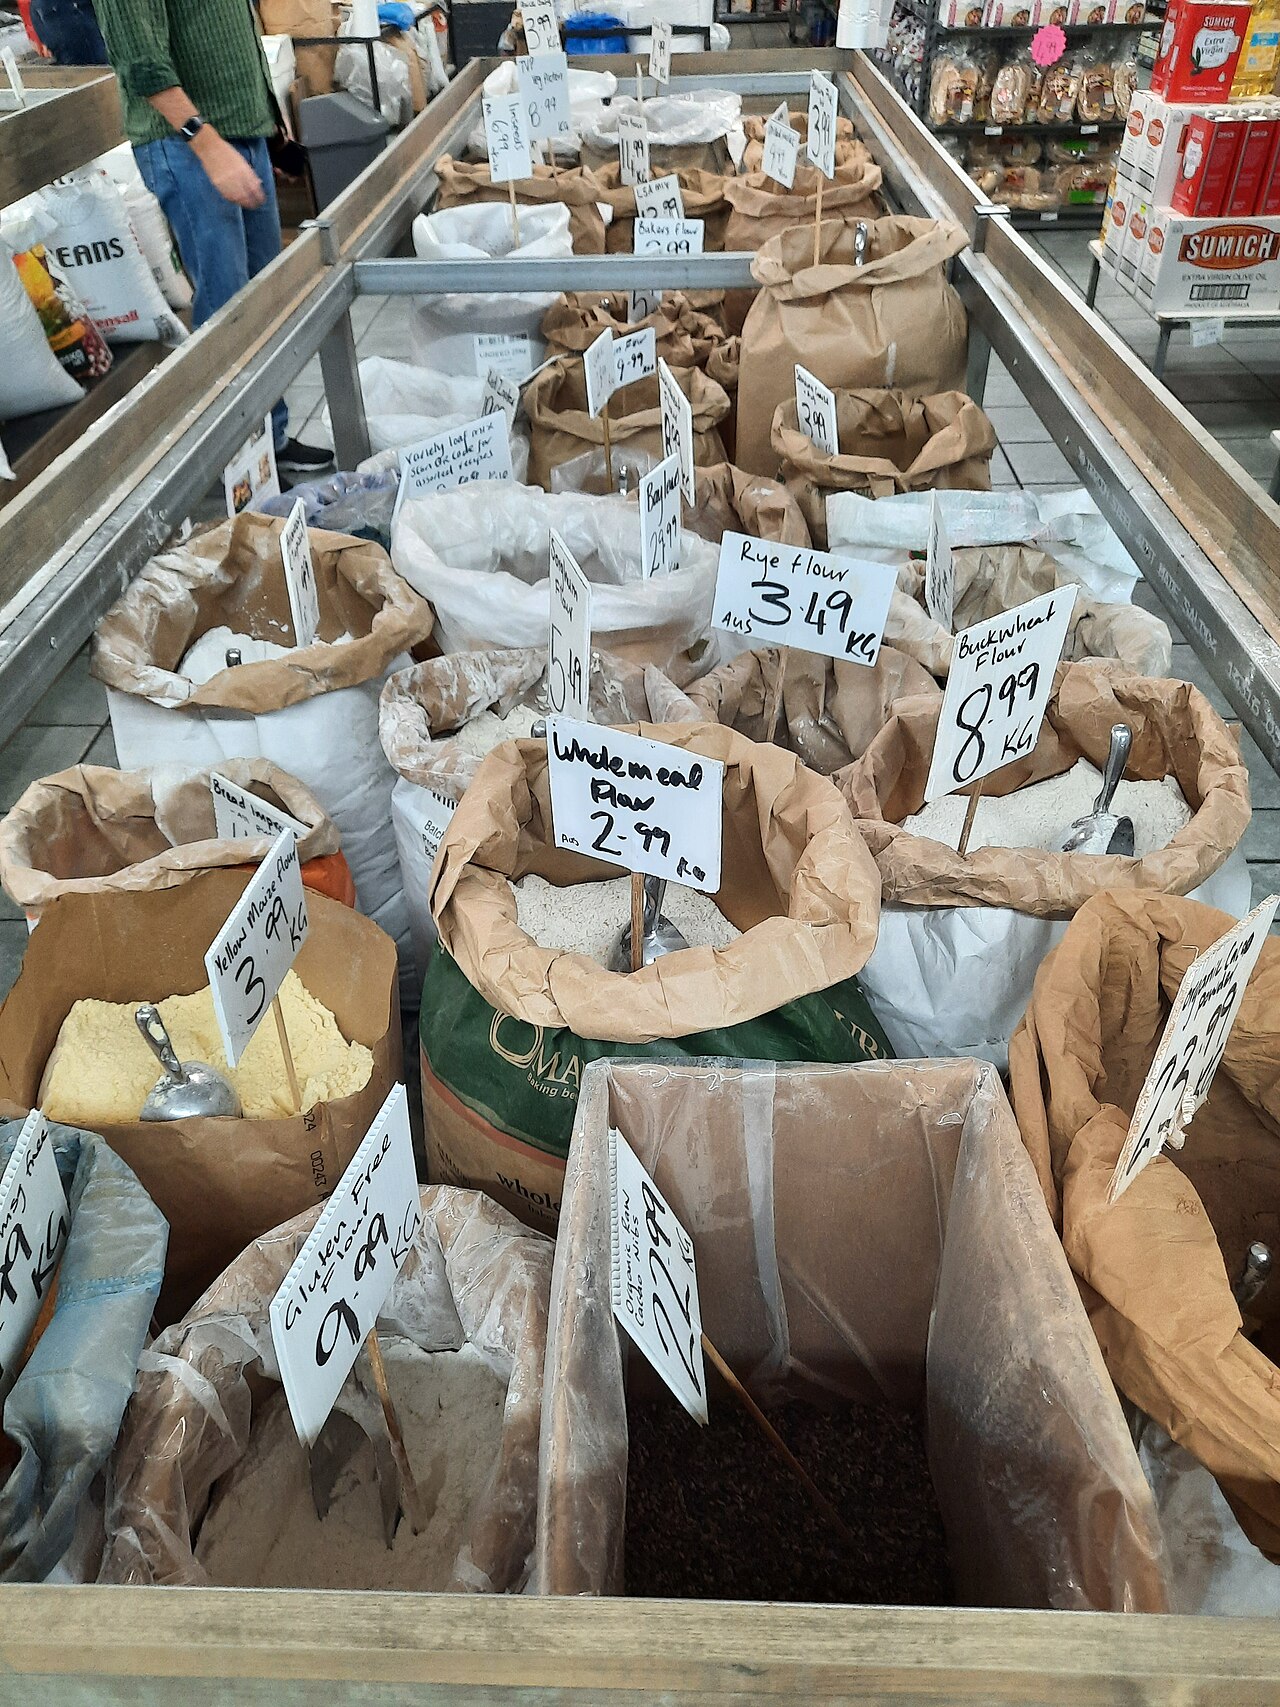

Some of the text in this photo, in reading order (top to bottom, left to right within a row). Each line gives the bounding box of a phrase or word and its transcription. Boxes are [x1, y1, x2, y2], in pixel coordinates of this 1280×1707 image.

[1204, 16, 1236, 28] SUMICH
[1201, 46, 1223, 56] Virgin
[1204, 38, 1224, 46] Extra
[53, 237, 125, 269] EANS
[1186, 232, 1275, 261] SUMICH
[740, 540, 780, 582] Rye
[748, 580, 854, 636] 3.49
[212, 778, 246, 809] Bread
[215, 926, 247, 976] Yellow
[249, 881, 277, 929] Maize
[489, 1008, 586, 1091] OMA
[526, 1072, 559, 1098] Baking
[284, 1133, 393, 1332] Gluten Free
